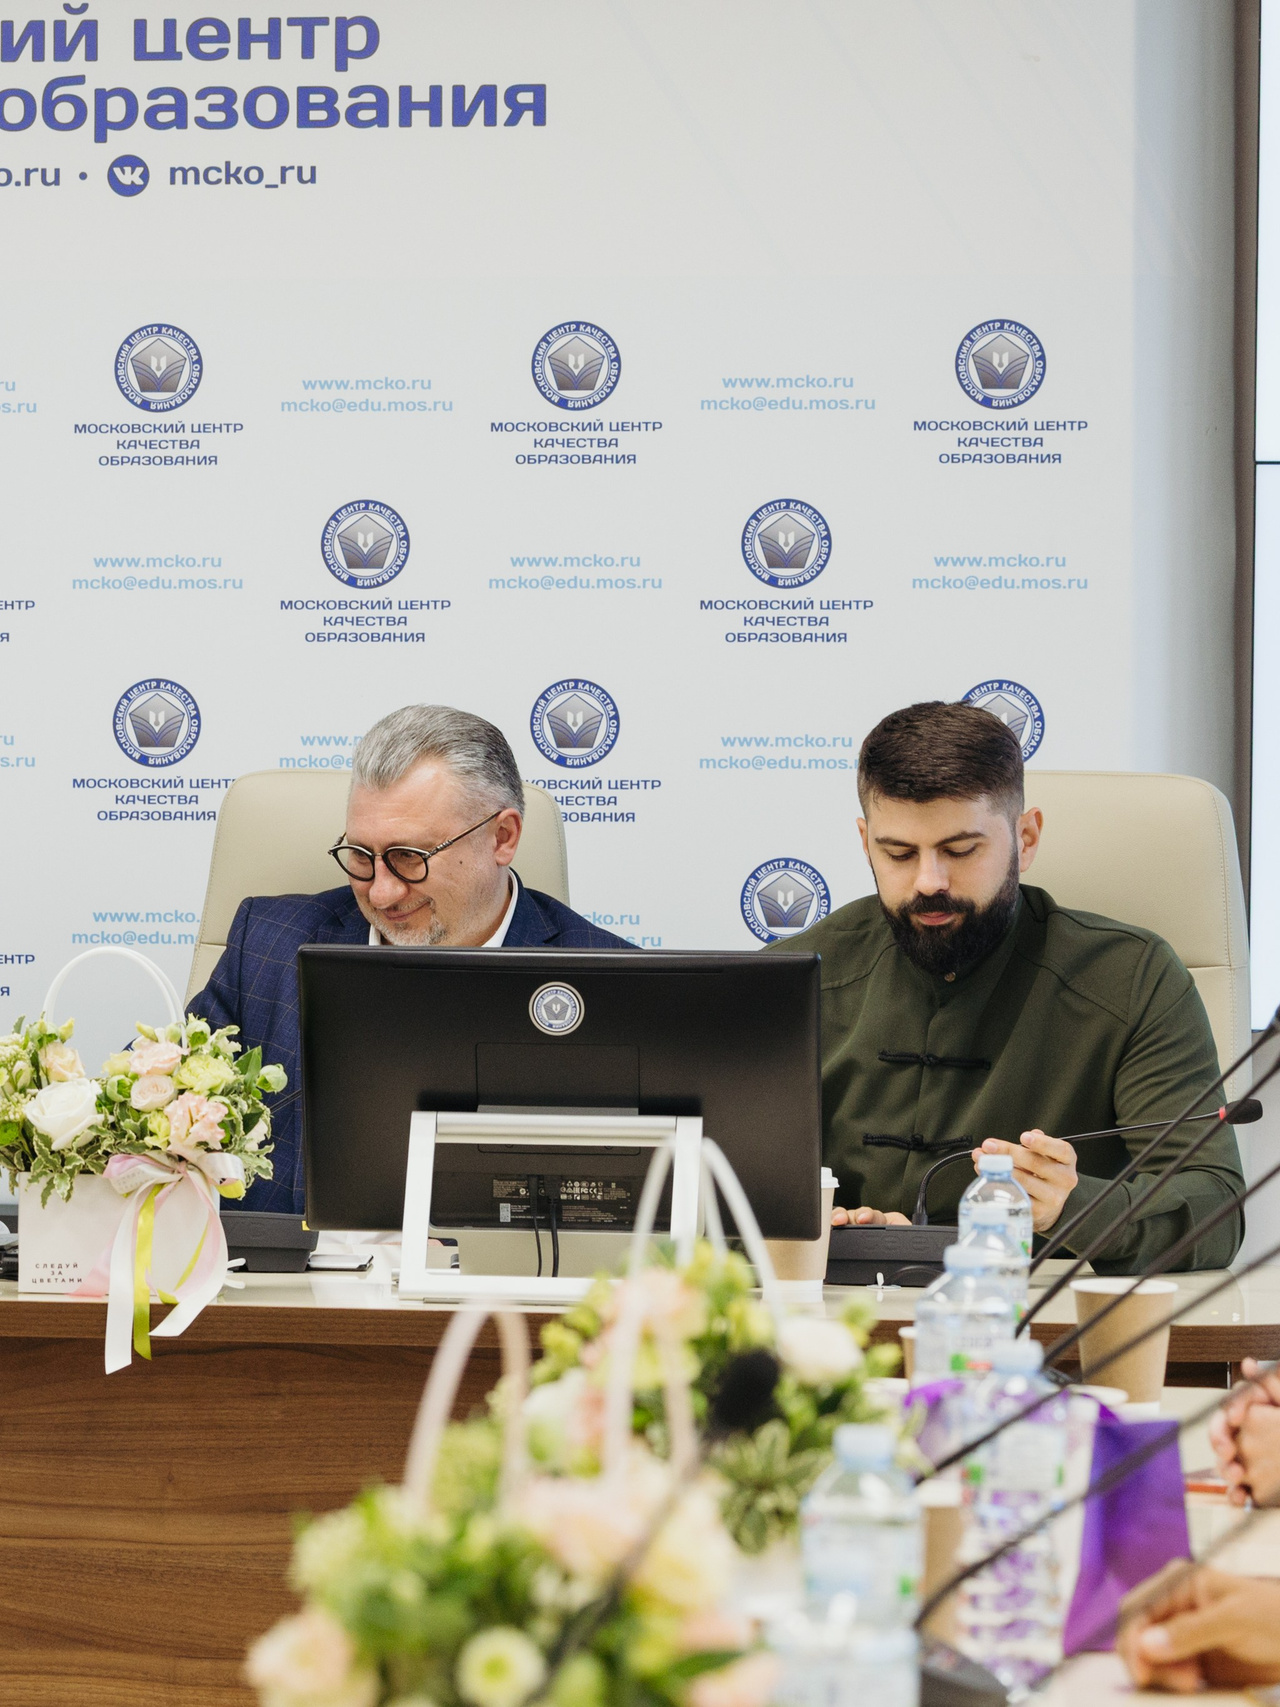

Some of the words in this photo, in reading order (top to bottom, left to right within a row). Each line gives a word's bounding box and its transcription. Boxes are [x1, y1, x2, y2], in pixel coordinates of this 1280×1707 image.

[132, 14, 381, 73] центр
[168, 160, 318, 190] mcko_ru
[129, 326, 158, 343] ЦЕНТР
[546, 324, 576, 341] ЦЕНТР
[970, 322, 1000, 340] ЦЕНТР
[162, 326, 199, 360] КАЧЕСТВА
[580, 324, 618, 358] КАЧЕСТВА
[1005, 322, 1043, 357] КАЧЕСТВА
[117, 345, 141, 405] МОСКОВСКИЙ
[534, 343, 558, 403] МОСКОВСКИЙ
[958, 341, 983, 402] МОСКОВСКИЙ
[150, 364, 200, 410] ОБРАЗОВАНИЯ
[302, 377, 431, 390] www.mcko.ru
[568, 362, 619, 408] ОБРАЗОВАНИЯ
[722, 375, 853, 388] www.mcko.ru
[992, 361, 1044, 407] ОБРАЗОВАНИЯ
[281, 399, 452, 412] mcko@edu.mos.ru
[701, 397, 875, 411] mcko@edu.mos.ru
[74, 420, 185, 434] МОСКОВСКИЙ
[191, 423, 243, 433] ЦЕНТР
[490, 419, 603, 432] МОСКОВСКИЙ
[609, 421, 663, 432] ЦЕНТР
[913, 418, 1028, 431] МОСКОВСКИЙ
[1034, 421, 1088, 431] ЦЕНТР
[117, 439, 200, 450] КАЧЕСТВА
[534, 438, 618, 448] КАЧЕСТВА
[957, 437, 1043, 447] КАЧЕСТВА
[98, 455, 218, 466] ОБРАЗОВАНИЯ
[515, 454, 636, 465] ОБРАЗОВАНИЯ
[939, 453, 1062, 464] ОБРАЗОВАНИЯ
[336, 502, 365, 519] ЦЕНТР
[756, 501, 786, 519] ЦЕНТР
[369, 502, 406, 536] КАЧЕСТВА
[790, 501, 828, 536] КАЧЕСТВА
[324, 521, 348, 581] МОСКОВСКИЙ
[744, 520, 768, 581] МОСКОВСКИЙ
[94, 555, 221, 567] www.mcko.ru
[357, 540, 407, 586] ОБРАЗОВАНИЯ
[511, 554, 640, 567] www.mcko.ru
[778, 540, 829, 586] ОБРАЗОВАНИЯ
[934, 554, 1066, 567] www.mcko.ru
[73, 576, 242, 590] mcko@edu.mos.ru
[489, 576, 662, 590] mcko@edu.mos.ru
[913, 576, 1088, 590] mcko@edu.mos.ru
[280, 597, 392, 610] МОСКОВСКИЙ
[398, 600, 451, 610] ЦЕНТР
[700, 597, 814, 610] МОСКОВСКИЙ
[820, 600, 873, 610] ЦЕНТР
[323, 616, 407, 626] КАЧЕСТВА
[744, 616, 829, 627] КАЧЕСТВА
[305, 632, 425, 643] ОБРАЗОВАНИЯ
[725, 632, 847, 643] ОБРАЗОВАНИЯ
[127, 681, 156, 698] ЦЕНТР
[545, 681, 574, 699] ЦЕНТР
[160, 681, 197, 715] КАЧЕСТВА
[579, 681, 616, 716] КАЧЕСТВА
[115, 700, 139, 760] МОСКОВСКИЙ
[533, 700, 557, 761] МОСКОВСКИЙ
[148, 719, 198, 765] ОБРАЗОВАНИЯ
[567, 720, 617, 766] ОБРАЗОВАНИЯ
[721, 734, 853, 748] www.mcko.ru
[72, 775, 184, 789] МОСКОВСКИЙ
[189, 778, 236, 790] ЦЕНТ
[608, 779, 662, 790] ЦЕНТР
[115, 794, 199, 805] КАЧЕСТВА
[554, 795, 618, 806] ЧЕСТВА
[97, 810, 217, 822] ОБРАЗОВАНИЯ
[562, 811, 636, 823] ЗОВАНИЯ
[743, 879, 767, 940] МОСКОВСКИЙ
[755, 860, 785, 878] ЦЕНТР
[789, 860, 827, 895] КАЧЕСТВА
[92, 909, 200, 923] www.mcko.
[71, 930, 199, 945] mcko@edu.m
